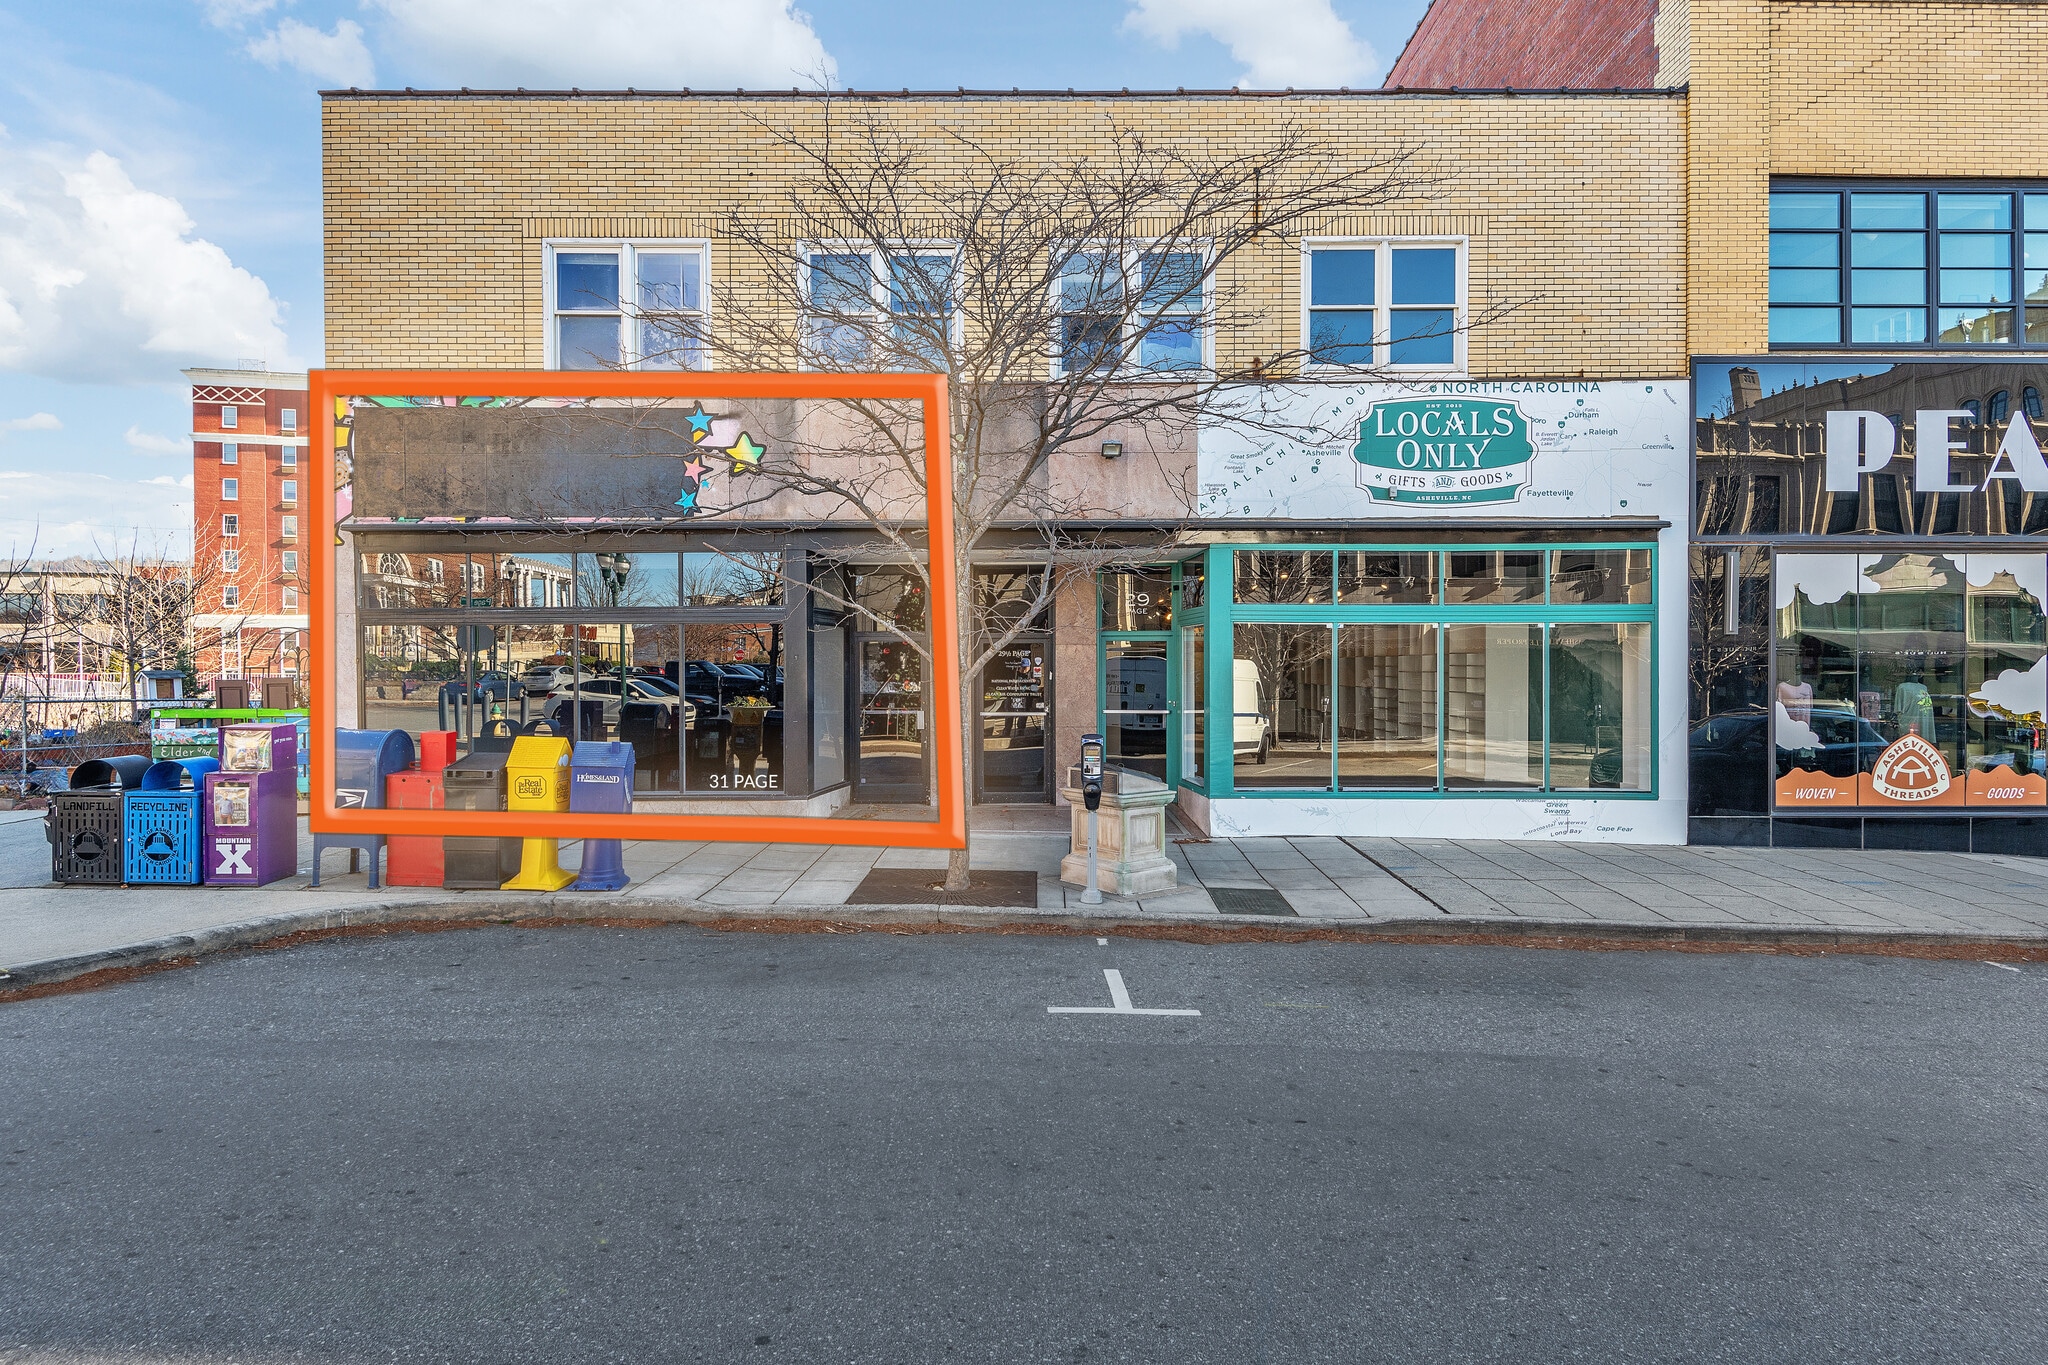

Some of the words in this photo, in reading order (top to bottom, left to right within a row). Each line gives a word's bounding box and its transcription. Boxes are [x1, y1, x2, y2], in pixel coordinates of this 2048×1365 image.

[1442, 382, 1502, 393] NORTH
[1511, 381, 1602, 393] CAROLINA
[1568, 411, 1600, 419] Durham
[1375, 407, 1515, 437] LOCALS
[1559, 433, 1575, 441] Cary
[1588, 428, 1618, 436] Raleigh
[1246, 449, 1264, 459] Smoky
[1396, 437, 1493, 469] ONLY
[1826, 410, 2048, 493] PEA
[1388, 474, 1426, 488] GIFTS
[1435, 475, 1454, 487] AND
[1460, 472, 1503, 487] GOODS
[1526, 489, 1574, 498] Fayetteville
[161, 746, 194, 757] Elder
[197, 746, 213, 756] and
[1882, 737, 1941, 768] ASHEVILLE
[524, 779, 542, 787] Real
[518, 785, 543, 794] Estate
[1795, 788, 1836, 799] WOVEN
[1884, 786, 1939, 800] THREADS
[1987, 787, 2026, 799] GOODS
[63, 801, 115, 811] LANDFILL
[131, 802, 188, 812] RECYCLING
[1550, 830, 1568, 838] Long
[1596, 825, 1615, 833] Cape
[155, 827, 179, 847] ASHEVILLE
[154, 849, 179, 867] CAROLINA
[215, 844, 252, 875] X
